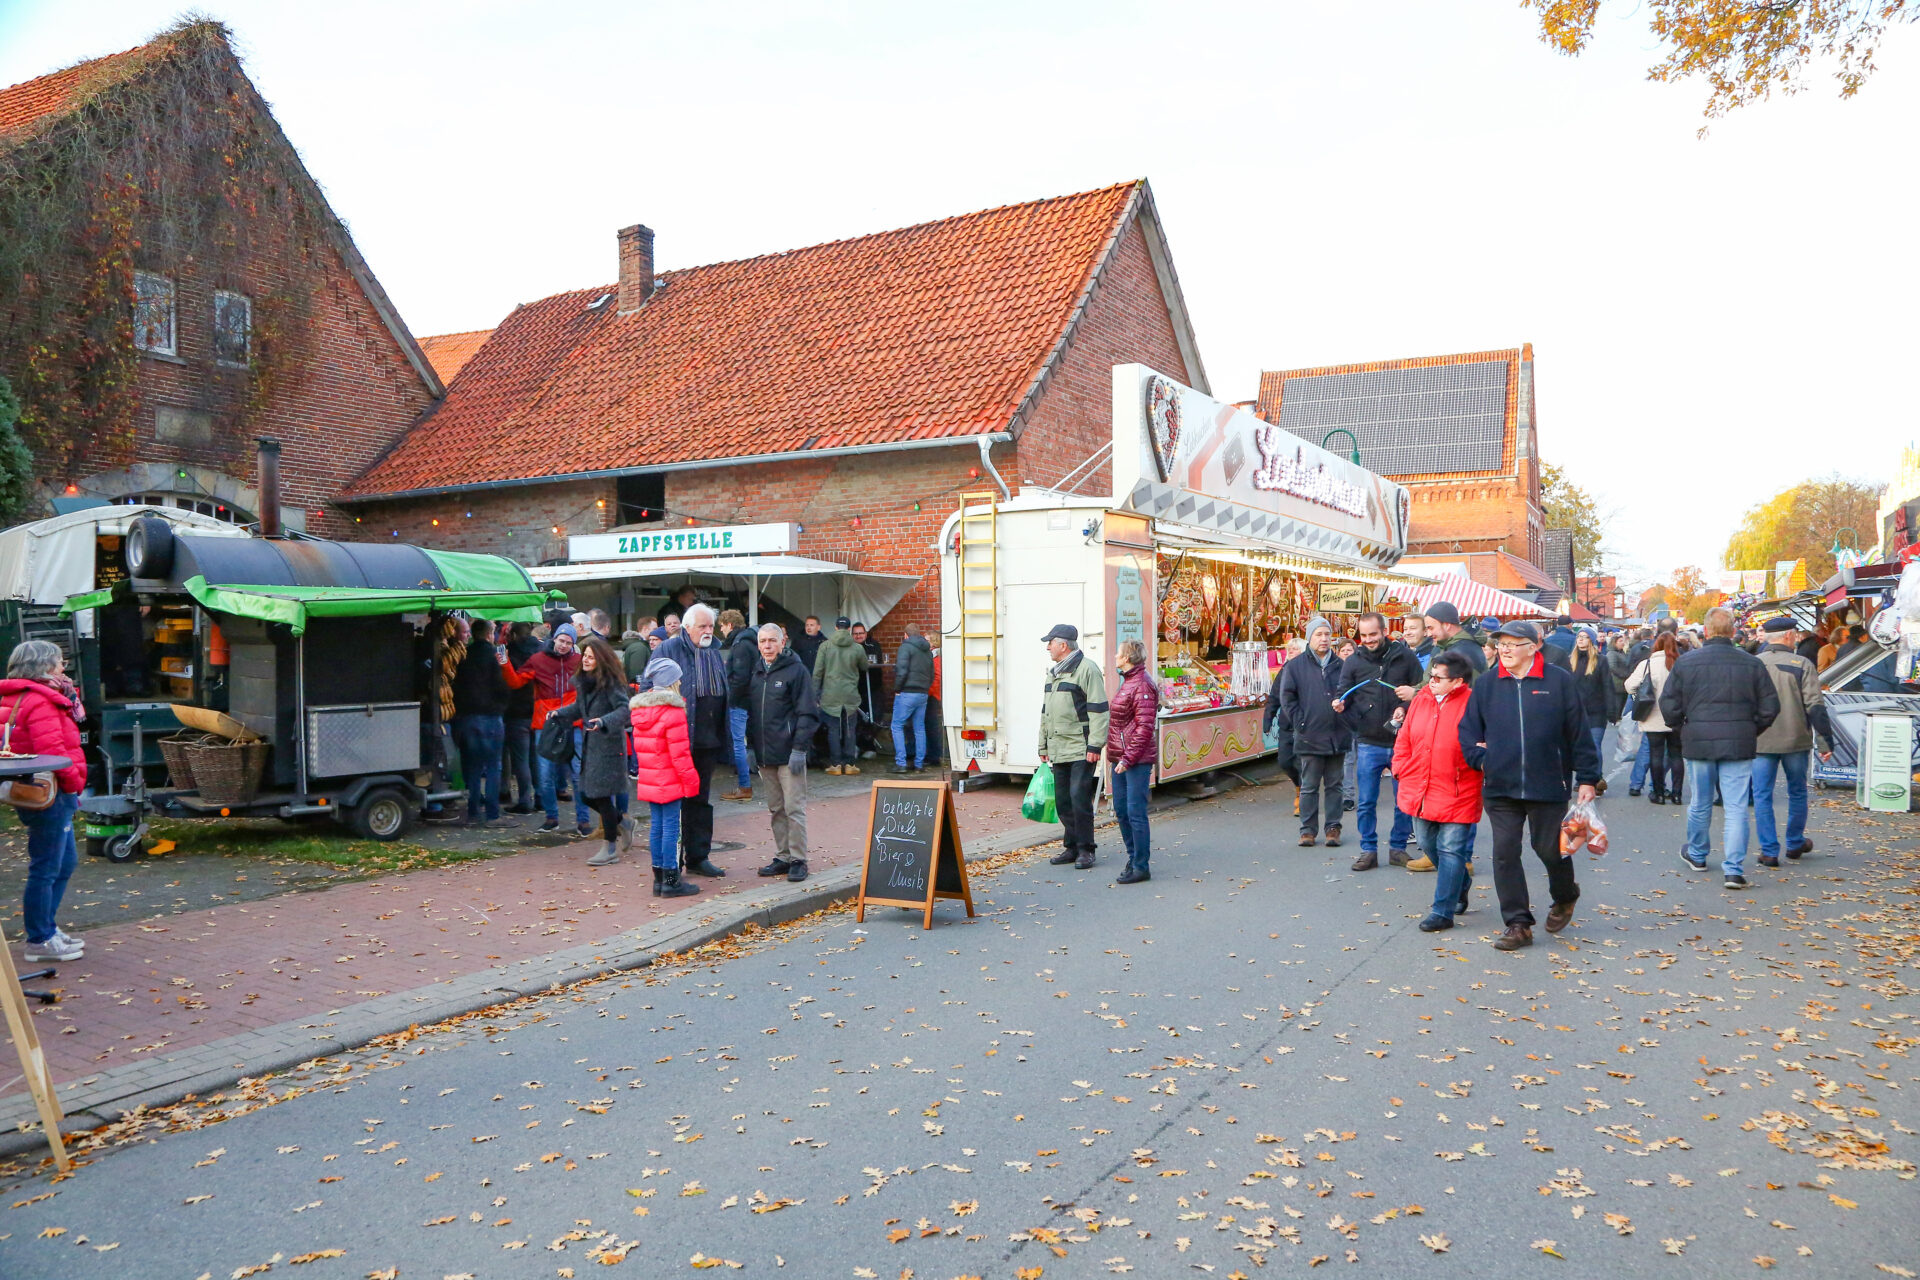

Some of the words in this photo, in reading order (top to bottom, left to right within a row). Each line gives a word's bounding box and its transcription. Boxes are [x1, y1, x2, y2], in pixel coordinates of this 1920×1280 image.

[618, 531, 733, 554] ZAPFSTELLE
[972, 740, 980, 749] NI
[972, 749, 986, 758] 468
[882, 794, 934, 817] beheizte
[885, 815, 917, 836] Diele
[877, 842, 904, 864] Bier
[888, 863, 924, 890] Musik
